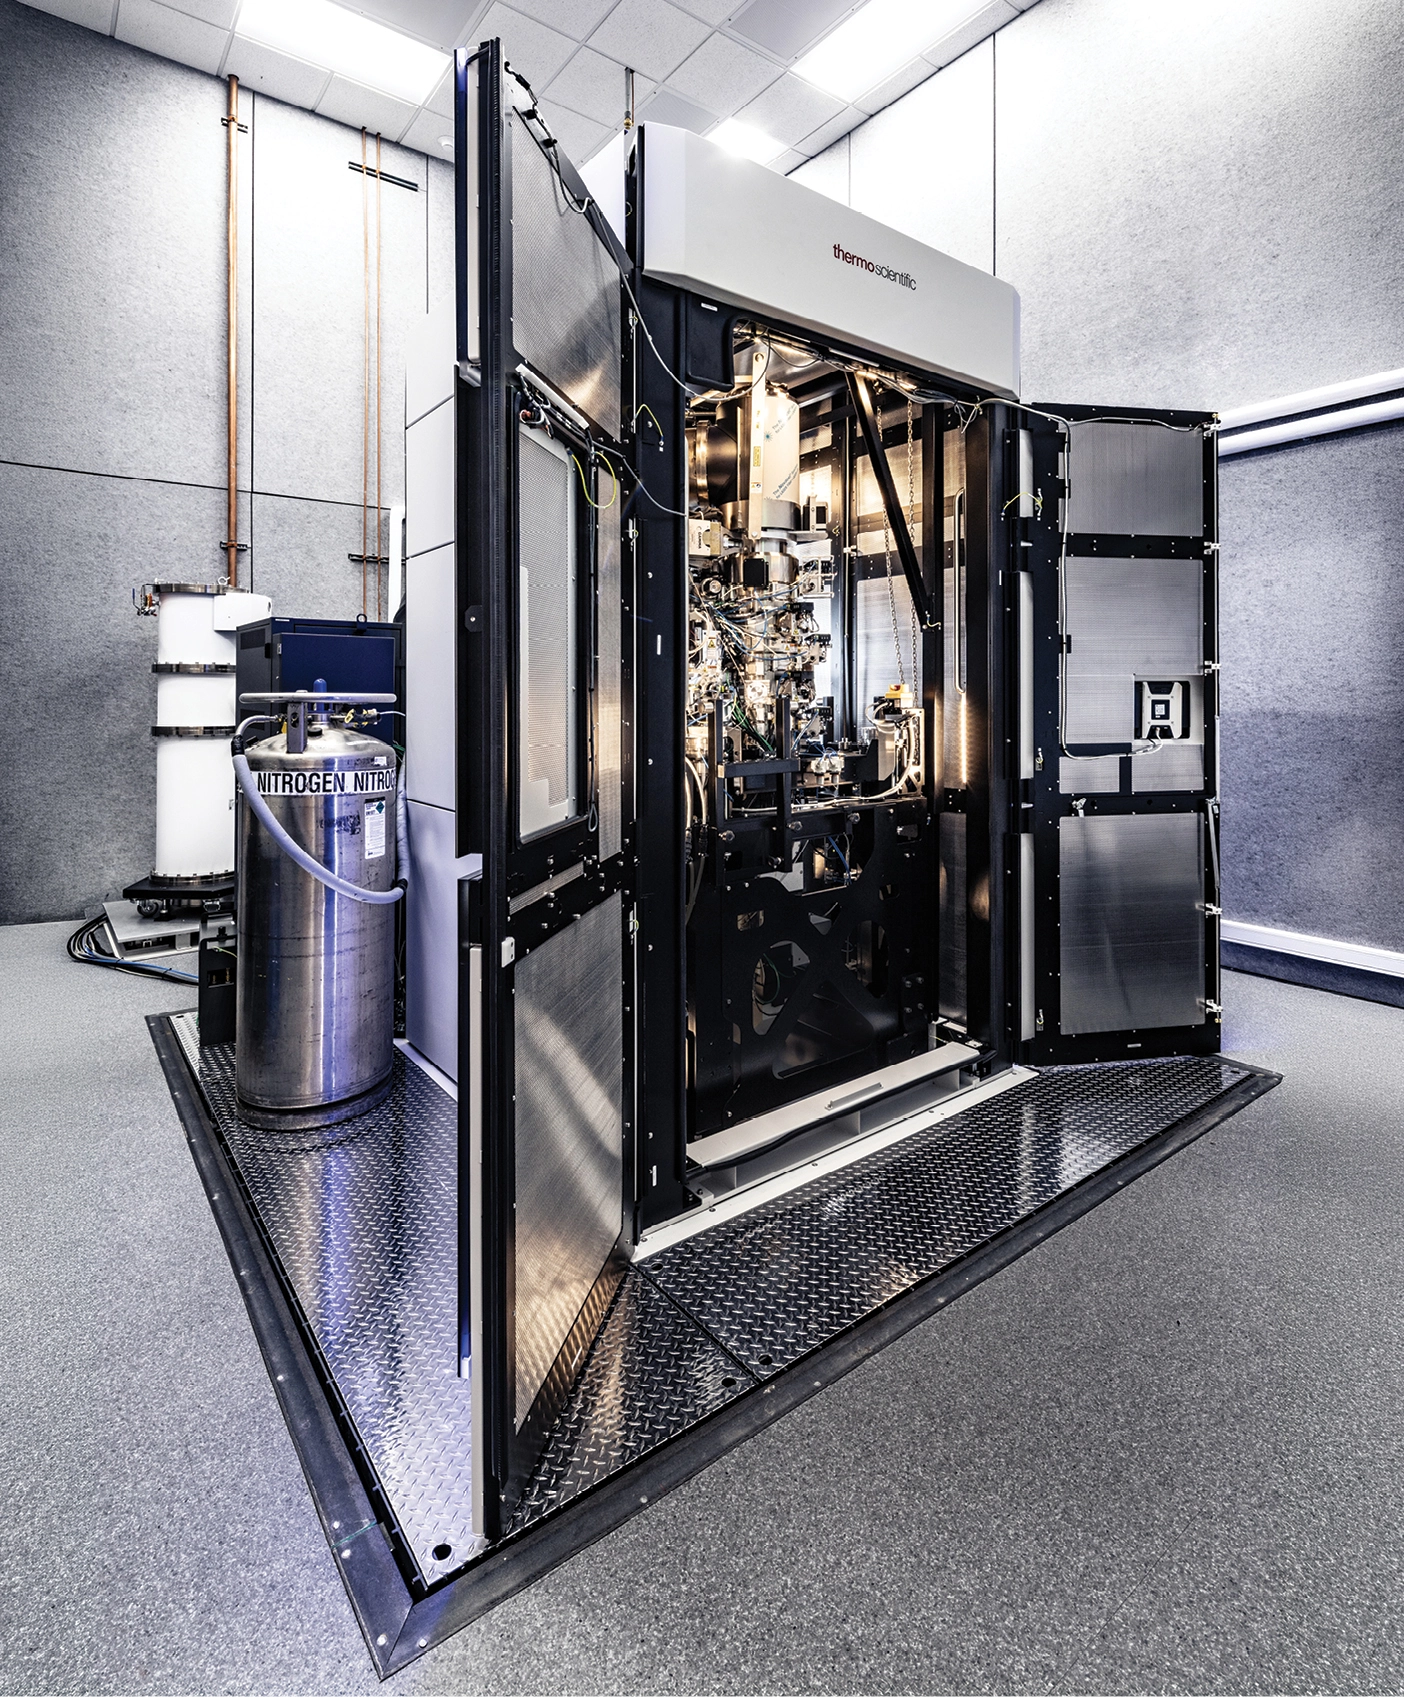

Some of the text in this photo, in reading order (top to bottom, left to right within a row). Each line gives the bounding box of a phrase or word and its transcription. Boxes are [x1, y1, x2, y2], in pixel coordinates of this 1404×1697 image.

[833, 243, 917, 291] thermo scientific
[258, 773, 345, 793] NITROGEN
